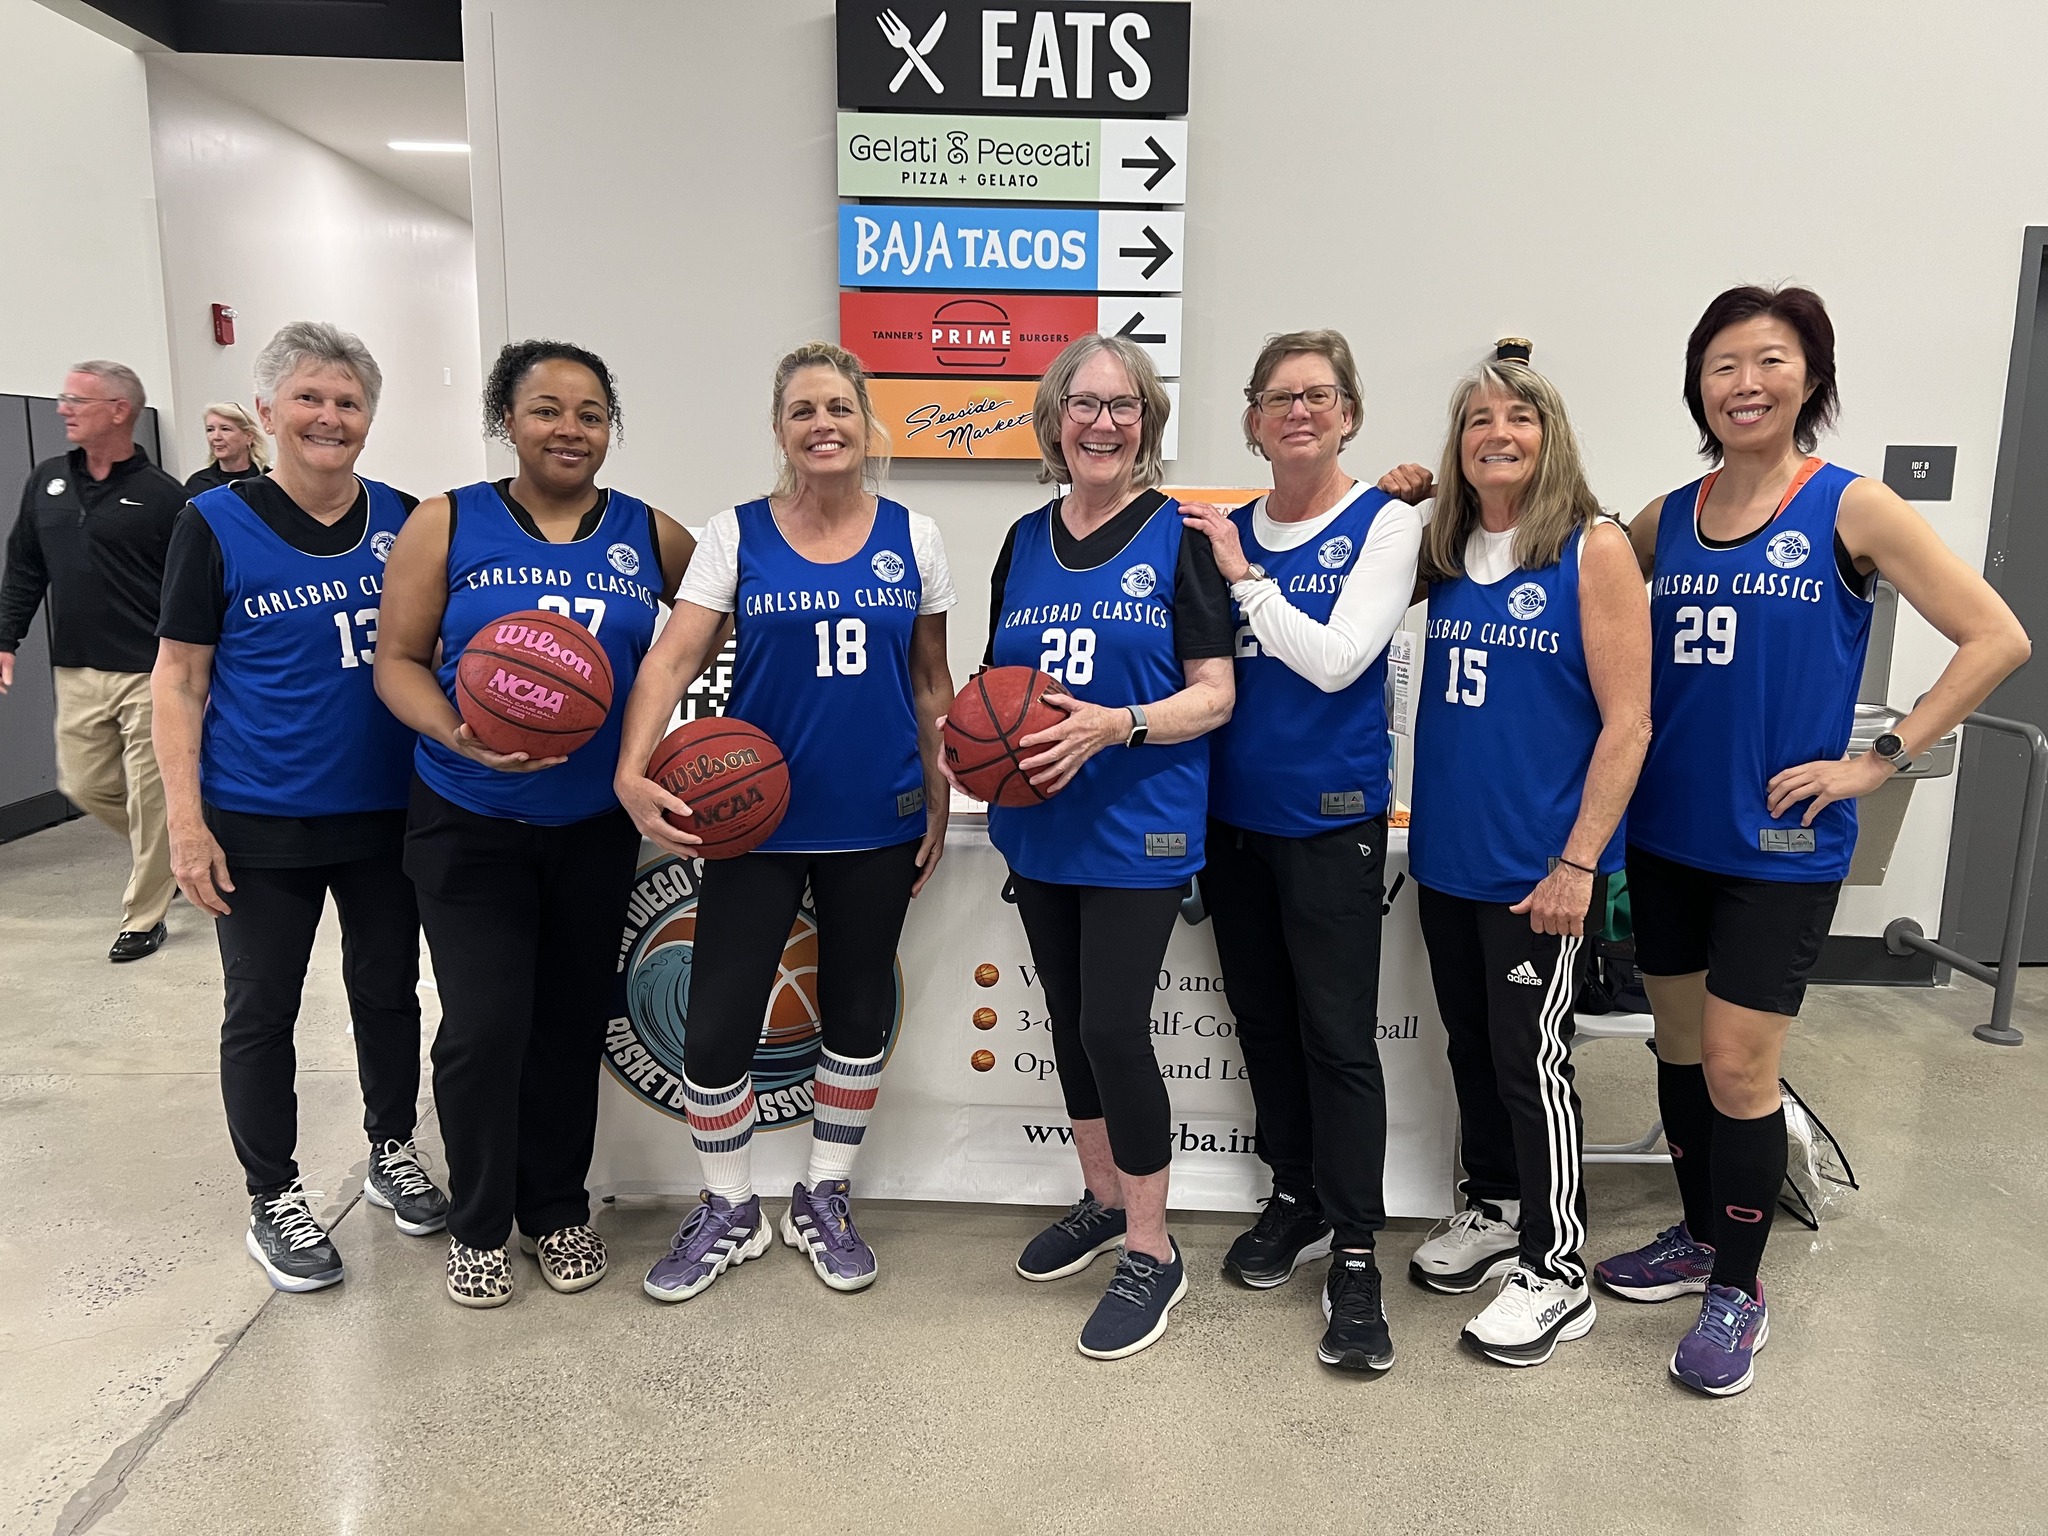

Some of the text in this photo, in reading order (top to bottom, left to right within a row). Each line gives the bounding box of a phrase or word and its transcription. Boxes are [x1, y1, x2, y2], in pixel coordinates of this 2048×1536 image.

[982, 10, 1151, 101] EATS
[849, 134, 938, 163] Gelati
[978, 138, 1091, 168] Peccati
[901, 172, 949, 185] PIZZA
[977, 174, 1039, 187] GELATO
[853, 216, 1087, 277] BAJA TACOS
[872, 328, 1070, 346] TANNER'S PRIME BURGERS
[905, 398, 1034, 456] Seaside Market
[1911, 461, 1923, 470] IDF
[1913, 470, 1927, 479] 150
[244, 580, 348, 619] CARLSBAD
[467, 567, 654, 609] CARLSBAD CLASSICS
[746, 587, 917, 617] CARLSBAD CLASSICS
[1732, 572, 1824, 603] CLASSICS
[1005, 600, 1168, 629] CARLSBAD CLASSICS
[333, 607, 381, 669] 13
[494, 625, 593, 681] Wilson
[815, 618, 867, 678] 18
[1480, 622, 1560, 654] CLASSICS
[1673, 606, 1738, 666] 29
[1040, 627, 1097, 686] 28
[487, 668, 565, 714] NCAA
[1445, 647, 1488, 708] 15
[537, 710, 556, 720] BALL
[660, 747, 762, 797] Wilson
[693, 785, 764, 829] NCAA
[1507, 973, 1543, 986] adidas
[1161, 1057, 1212, 1080] and
[1345, 1260, 1366, 1269] HOKA
[1535, 1298, 1568, 1331] HOKA
